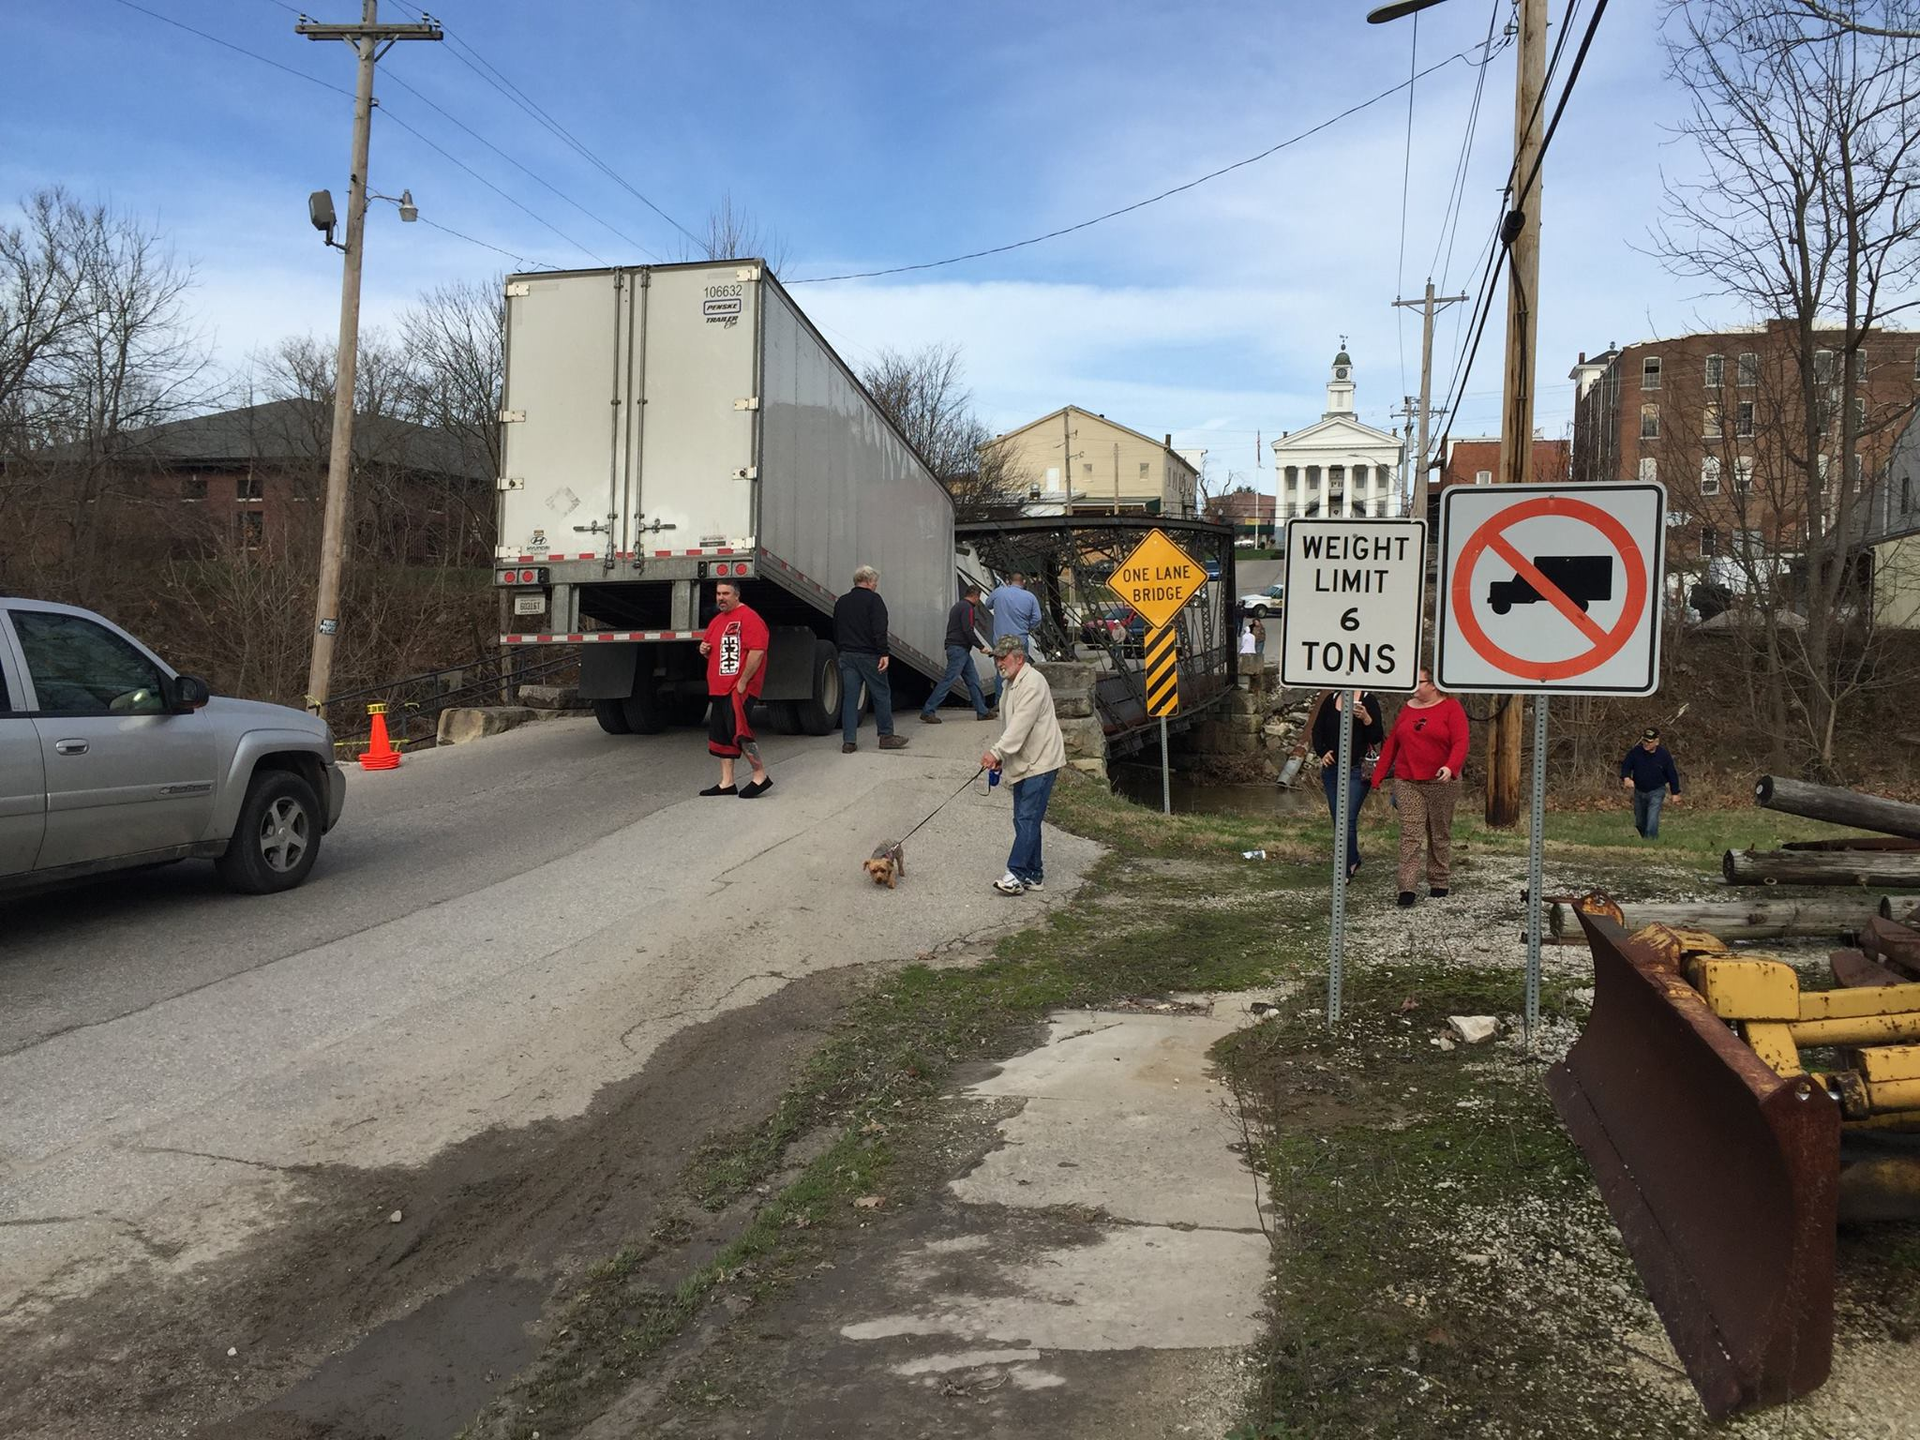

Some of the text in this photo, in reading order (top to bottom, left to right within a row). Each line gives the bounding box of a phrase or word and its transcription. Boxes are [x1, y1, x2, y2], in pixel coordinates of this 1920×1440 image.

[704, 284, 743, 298] 106632
[706, 303, 738, 311] PENSKE
[706, 315, 739, 324] TRAILER
[1302, 535, 1410, 561] WEIGHT
[1122, 565, 1191, 583] ONE LANE
[1315, 568, 1389, 594] LIMIT
[1132, 586, 1183, 602] BRIDGE
[1340, 607, 1360, 632] 6
[1301, 641, 1396, 674] TONS
